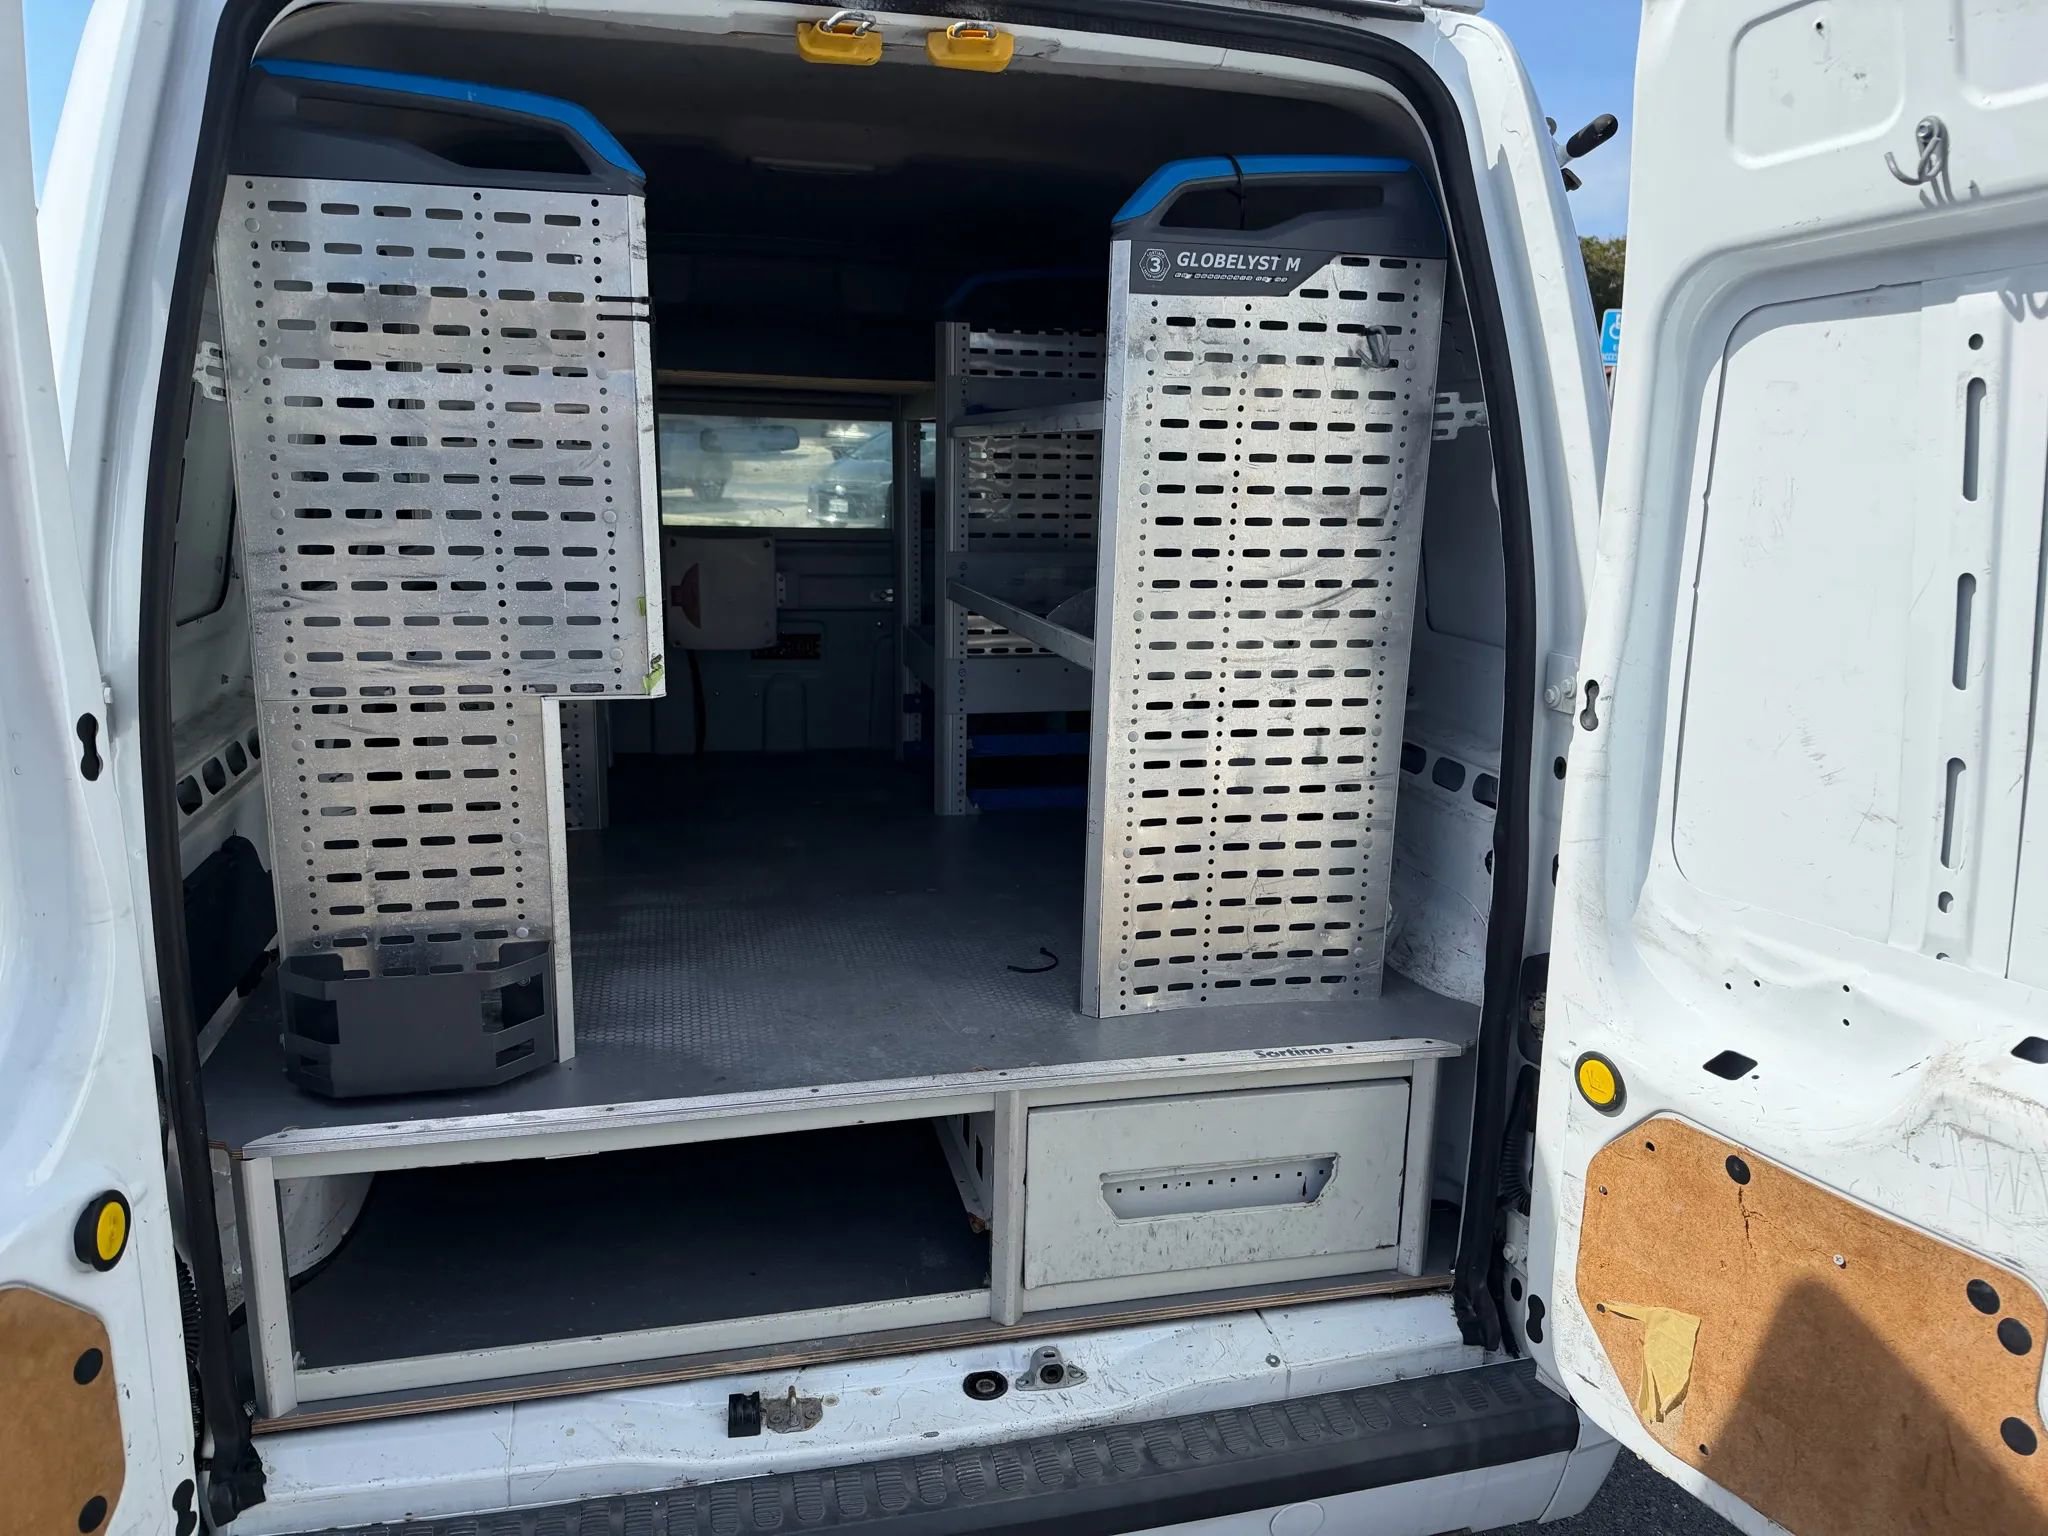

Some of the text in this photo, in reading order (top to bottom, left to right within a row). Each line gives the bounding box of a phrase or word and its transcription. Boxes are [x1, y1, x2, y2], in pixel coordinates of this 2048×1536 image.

[1150, 257, 1161, 273] 3
[1176, 251, 1281, 271] GLOBELYST
[1285, 256, 1301, 272] M
